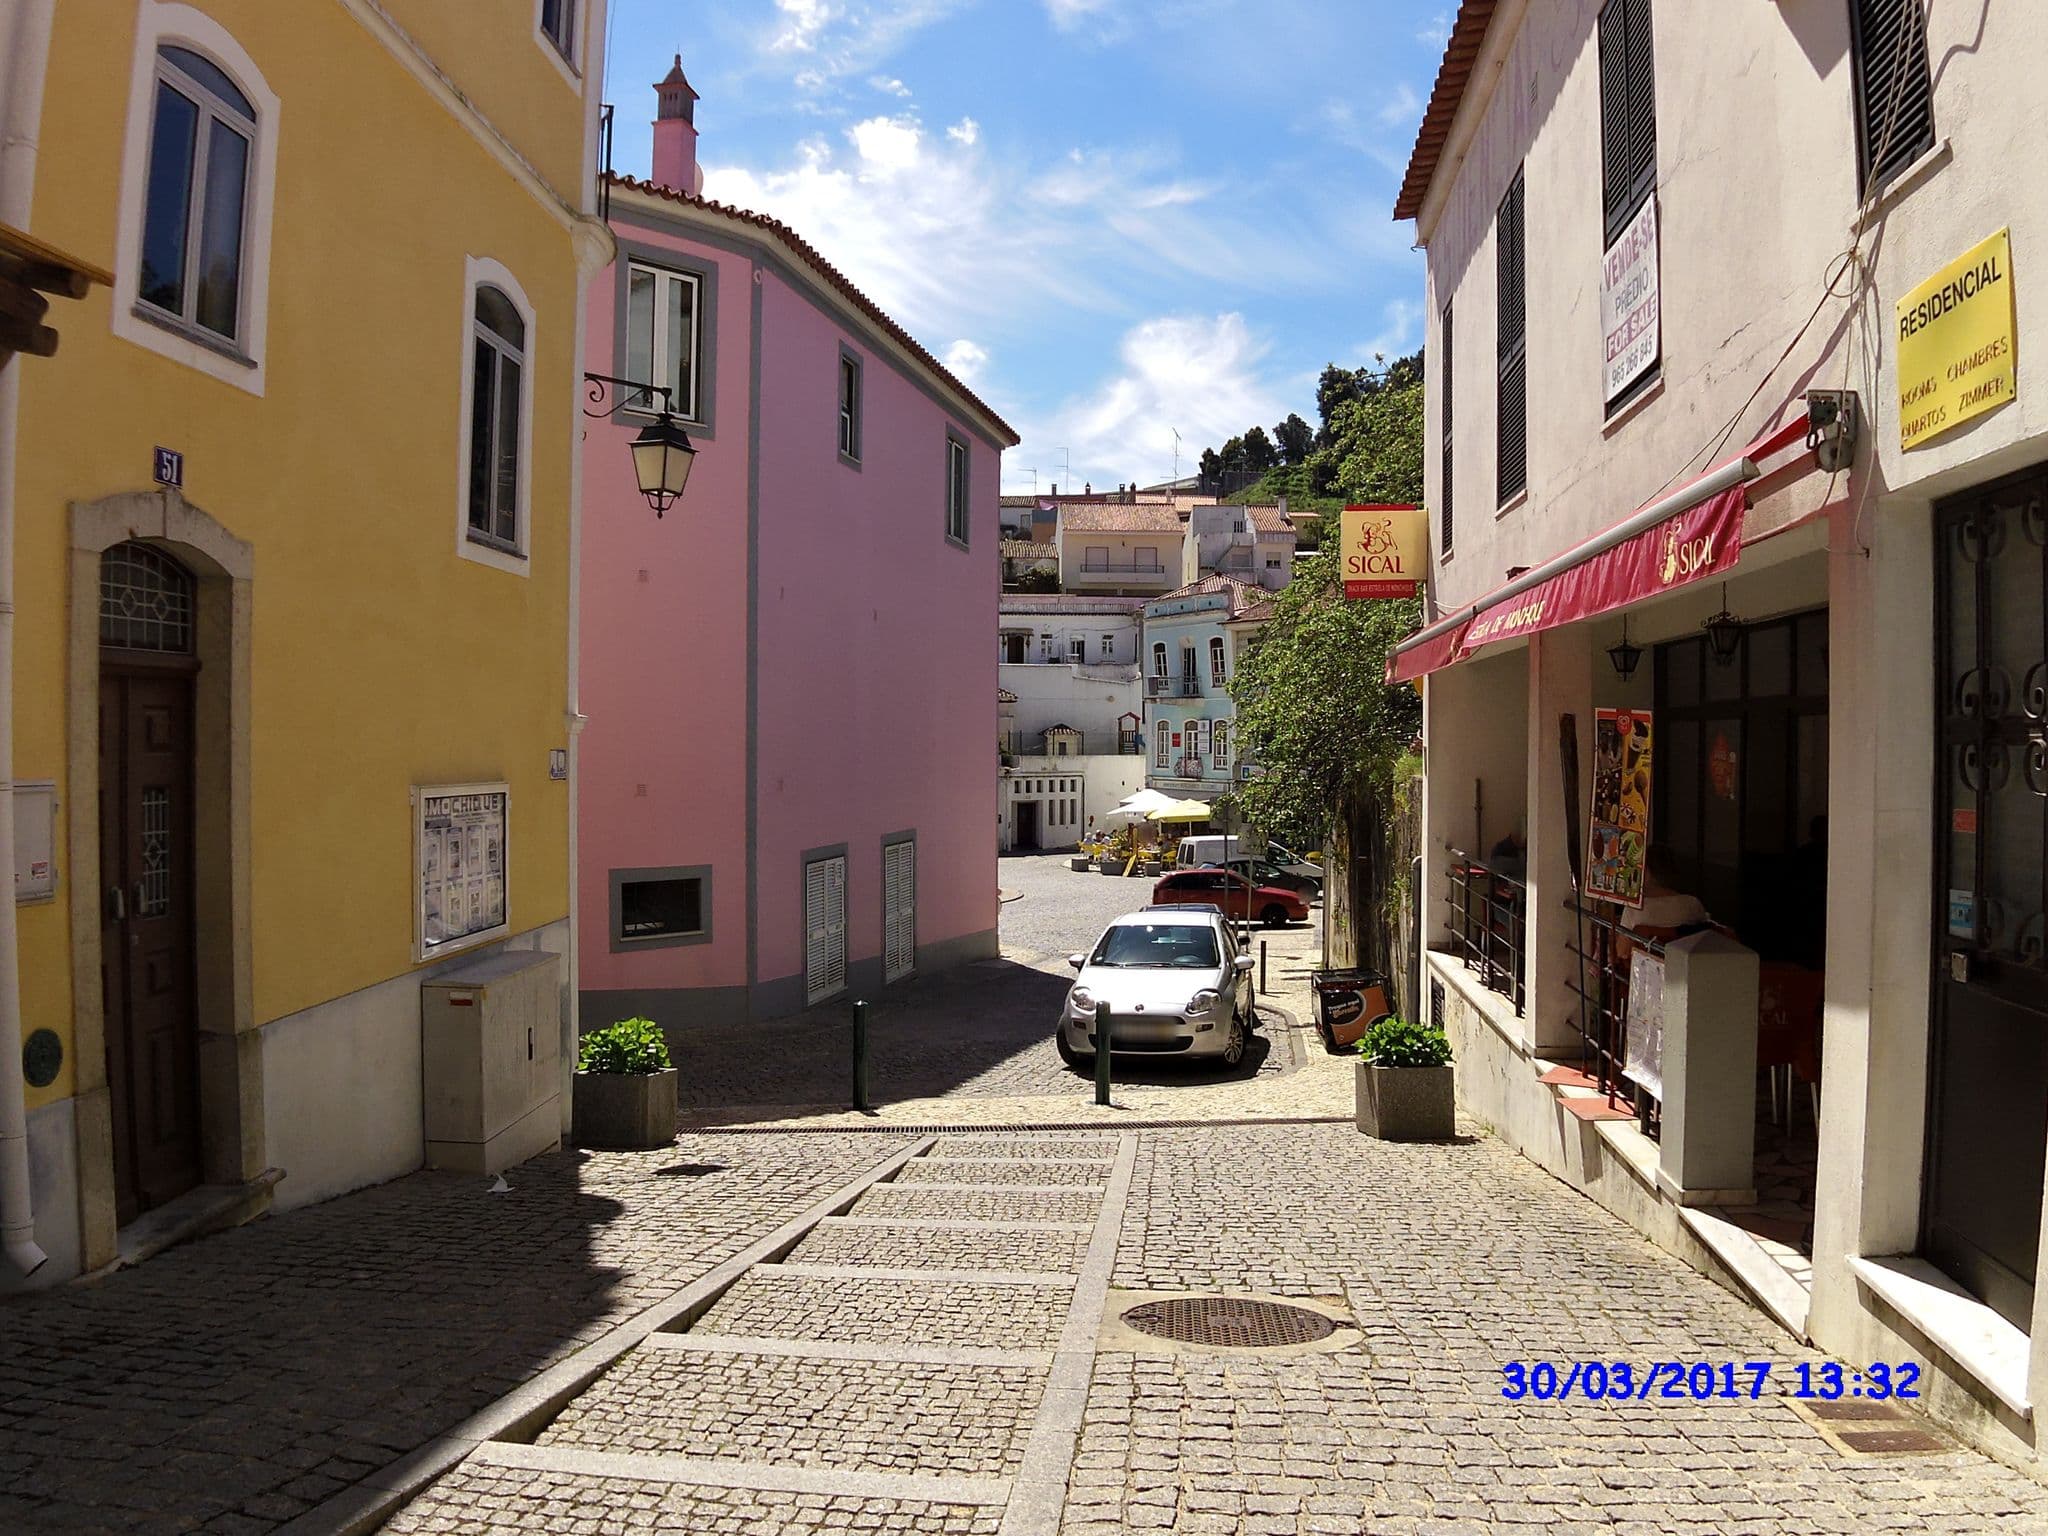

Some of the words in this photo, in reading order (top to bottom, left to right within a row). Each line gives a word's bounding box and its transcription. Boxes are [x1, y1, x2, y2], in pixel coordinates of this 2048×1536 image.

[1608, 323, 1630, 360] FOR
[1631, 295, 1656, 339] SALE
[1900, 256, 2002, 342] RESIDENCIAL
[1901, 376, 1937, 410] ROOMS
[1947, 336, 2008, 382] CHAMBRES
[1901, 405, 1947, 441] QUARTOS
[1958, 375, 2004, 412] ZIMMER
[162, 452, 178, 483] 51
[1348, 555, 1405, 574] SICAL
